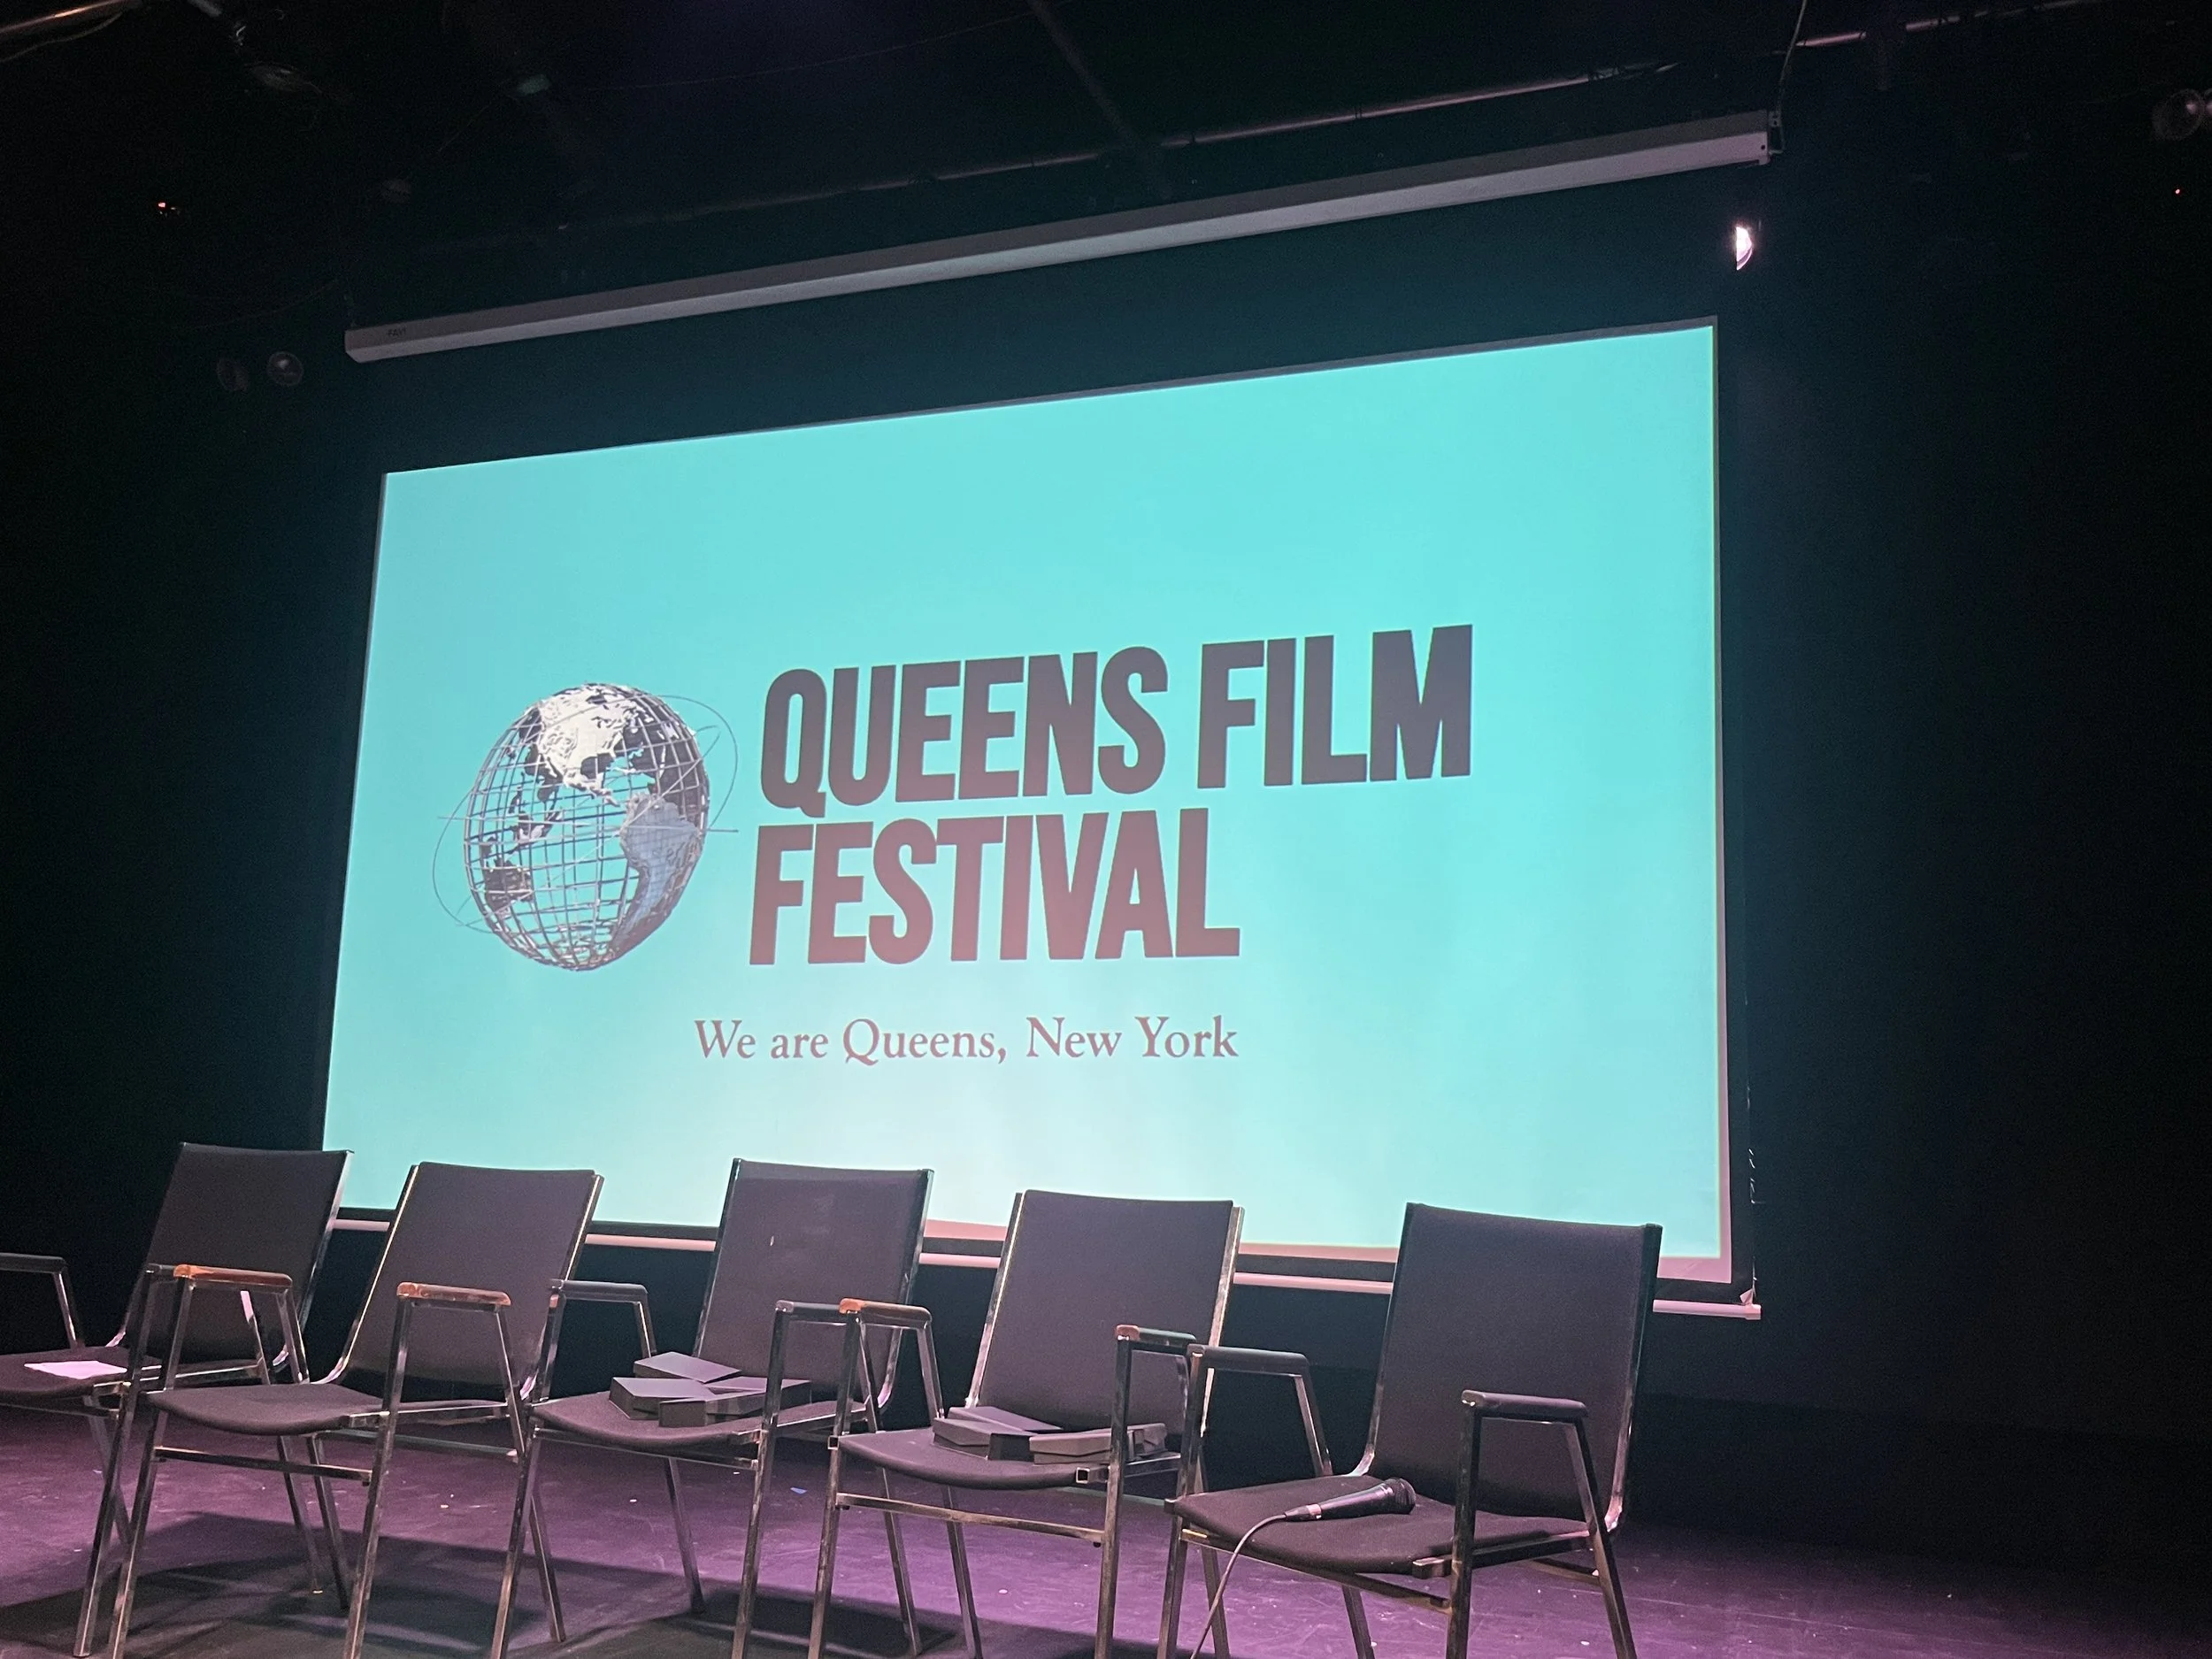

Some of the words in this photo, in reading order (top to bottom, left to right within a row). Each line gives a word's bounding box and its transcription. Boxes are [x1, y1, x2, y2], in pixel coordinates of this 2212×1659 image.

[760, 646, 1169, 818] QUEENS
[1197, 624, 1473, 789] FILM
[749, 807, 1240, 965] FESTIVAL
[694, 1018, 757, 1059] We
[770, 1033, 829, 1060] are
[841, 1018, 1007, 1066] Queens,
[1026, 1017, 1123, 1058] New
[1133, 1014, 1240, 1058] York
